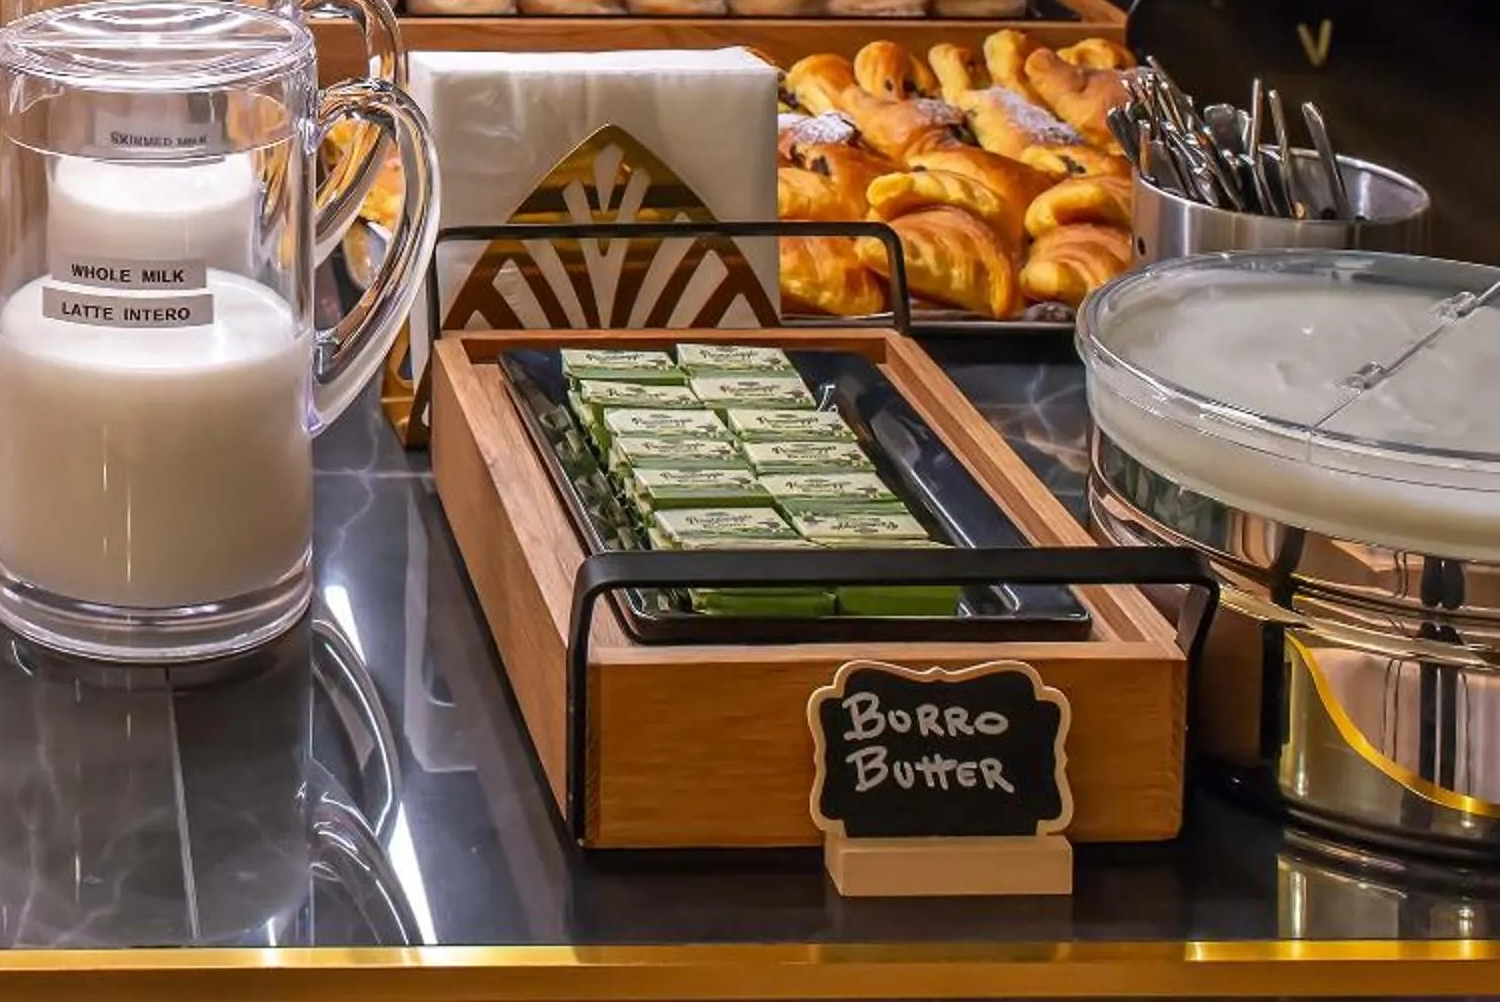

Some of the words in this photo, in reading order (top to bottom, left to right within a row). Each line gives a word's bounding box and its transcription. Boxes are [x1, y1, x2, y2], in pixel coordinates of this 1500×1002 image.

[71, 264, 130, 283] WHOLE
[141, 270, 184, 283] MILK
[61, 302, 113, 320] LATTE
[123, 308, 190, 321] INTERO
[842, 691, 1009, 741] BORRO
[845, 745, 1015, 794] BUTTER
